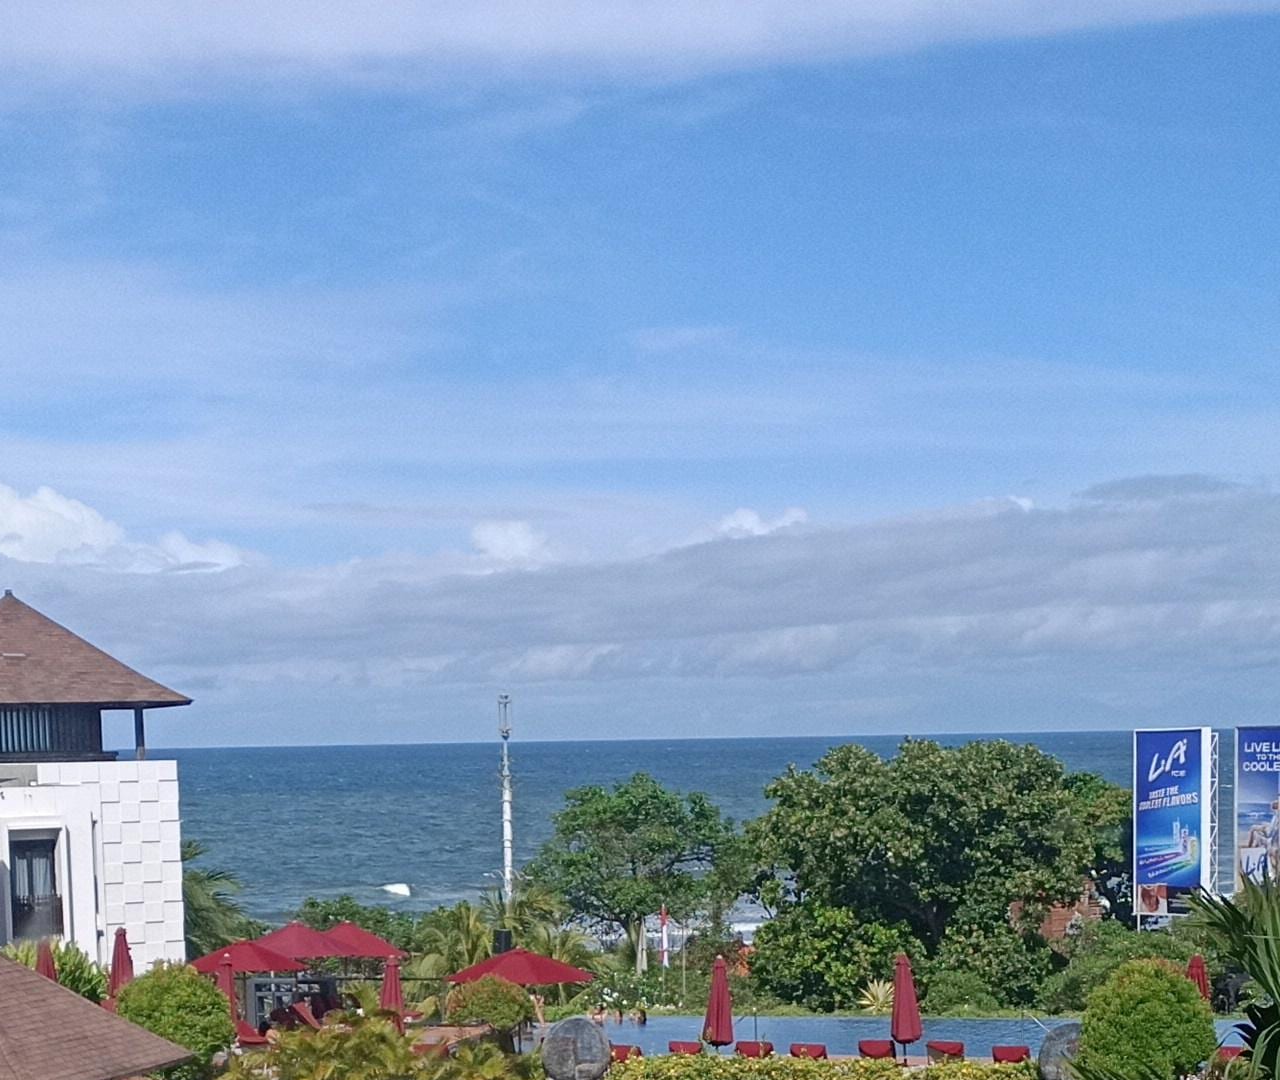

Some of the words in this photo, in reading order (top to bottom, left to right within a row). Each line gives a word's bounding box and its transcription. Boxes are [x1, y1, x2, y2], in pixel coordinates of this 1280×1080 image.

[1244, 742, 1270, 752] LIVE
[1166, 785, 1179, 796] THE
[1162, 792, 1198, 807] FLAVORS
